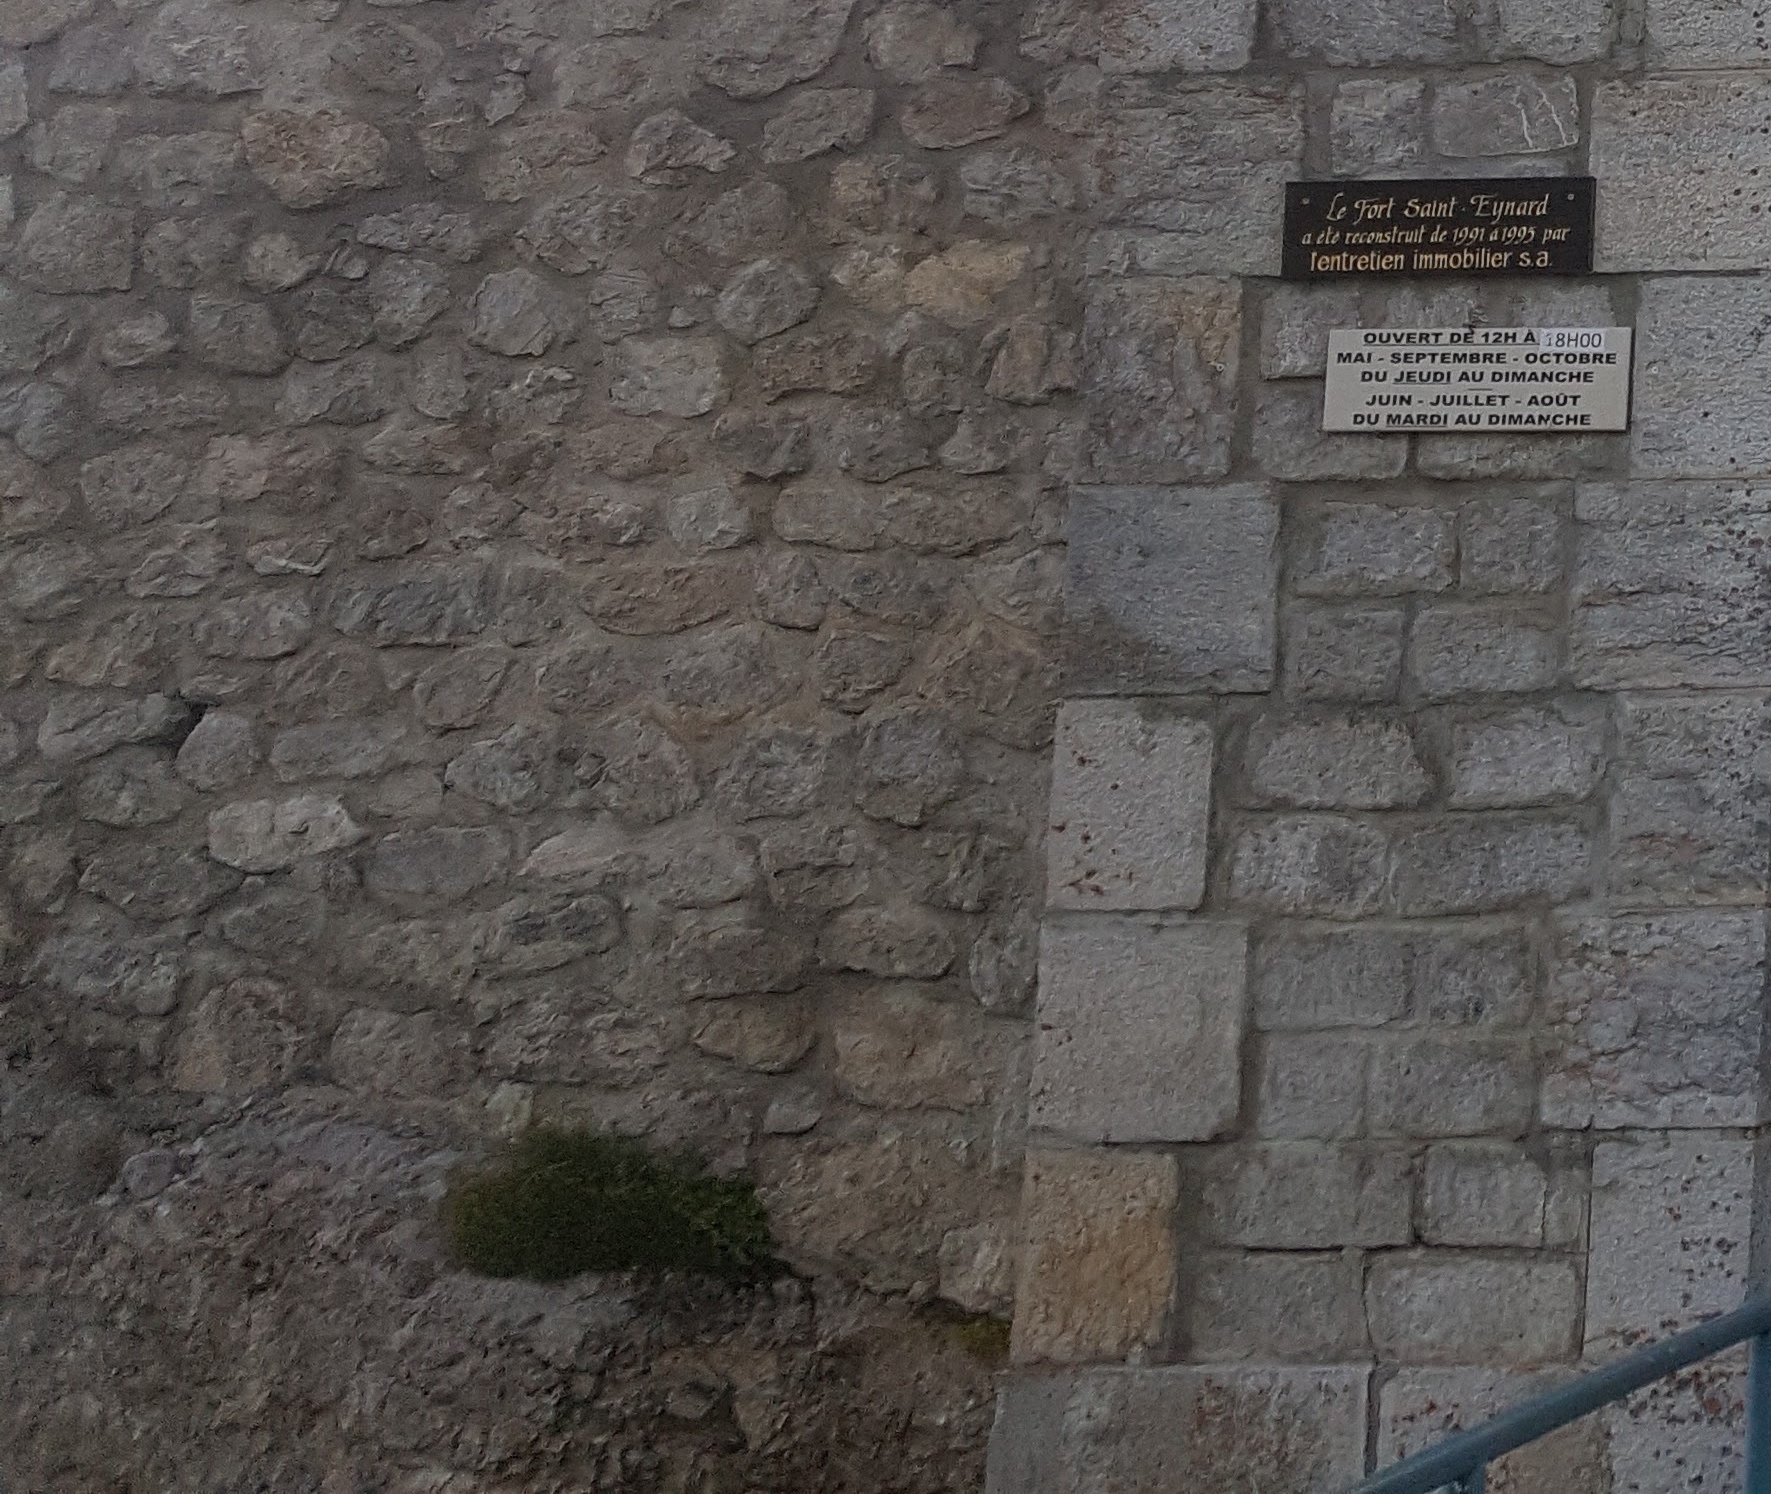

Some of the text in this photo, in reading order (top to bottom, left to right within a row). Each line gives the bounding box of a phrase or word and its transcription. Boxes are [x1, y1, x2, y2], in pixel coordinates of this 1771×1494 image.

[1326, 192, 1347, 221] Le
[1352, 197, 1396, 225] Fort
[1404, 197, 1458, 218] Saint
[1470, 193, 1549, 225] Eynard
[1301, 232, 1312, 244] a
[1345, 225, 1426, 244] reconstruit
[1430, 224, 1448, 243] de
[1453, 226, 1485, 246] 1991
[1501, 226, 1537, 246] 1995
[1541, 227, 1571, 245] par
[1413, 247, 1513, 270] immobilier
[1363, 329, 1602, 348] OUVERT DE 12H À 18H00
[1337, 352, 1372, 364] MAI
[1390, 352, 1507, 364] SEPTEMBRE
[1525, 352, 1617, 364] OCTOBRE
[1361, 371, 1595, 384] DU JEUDI AU DIMANCHE
[1365, 394, 1412, 406] JUIN
[1429, 394, 1510, 406] JUILLET
[1527, 393, 1581, 406] AOÛT
[1352, 413, 1592, 426] DU MARDI AU DIMANCHE
